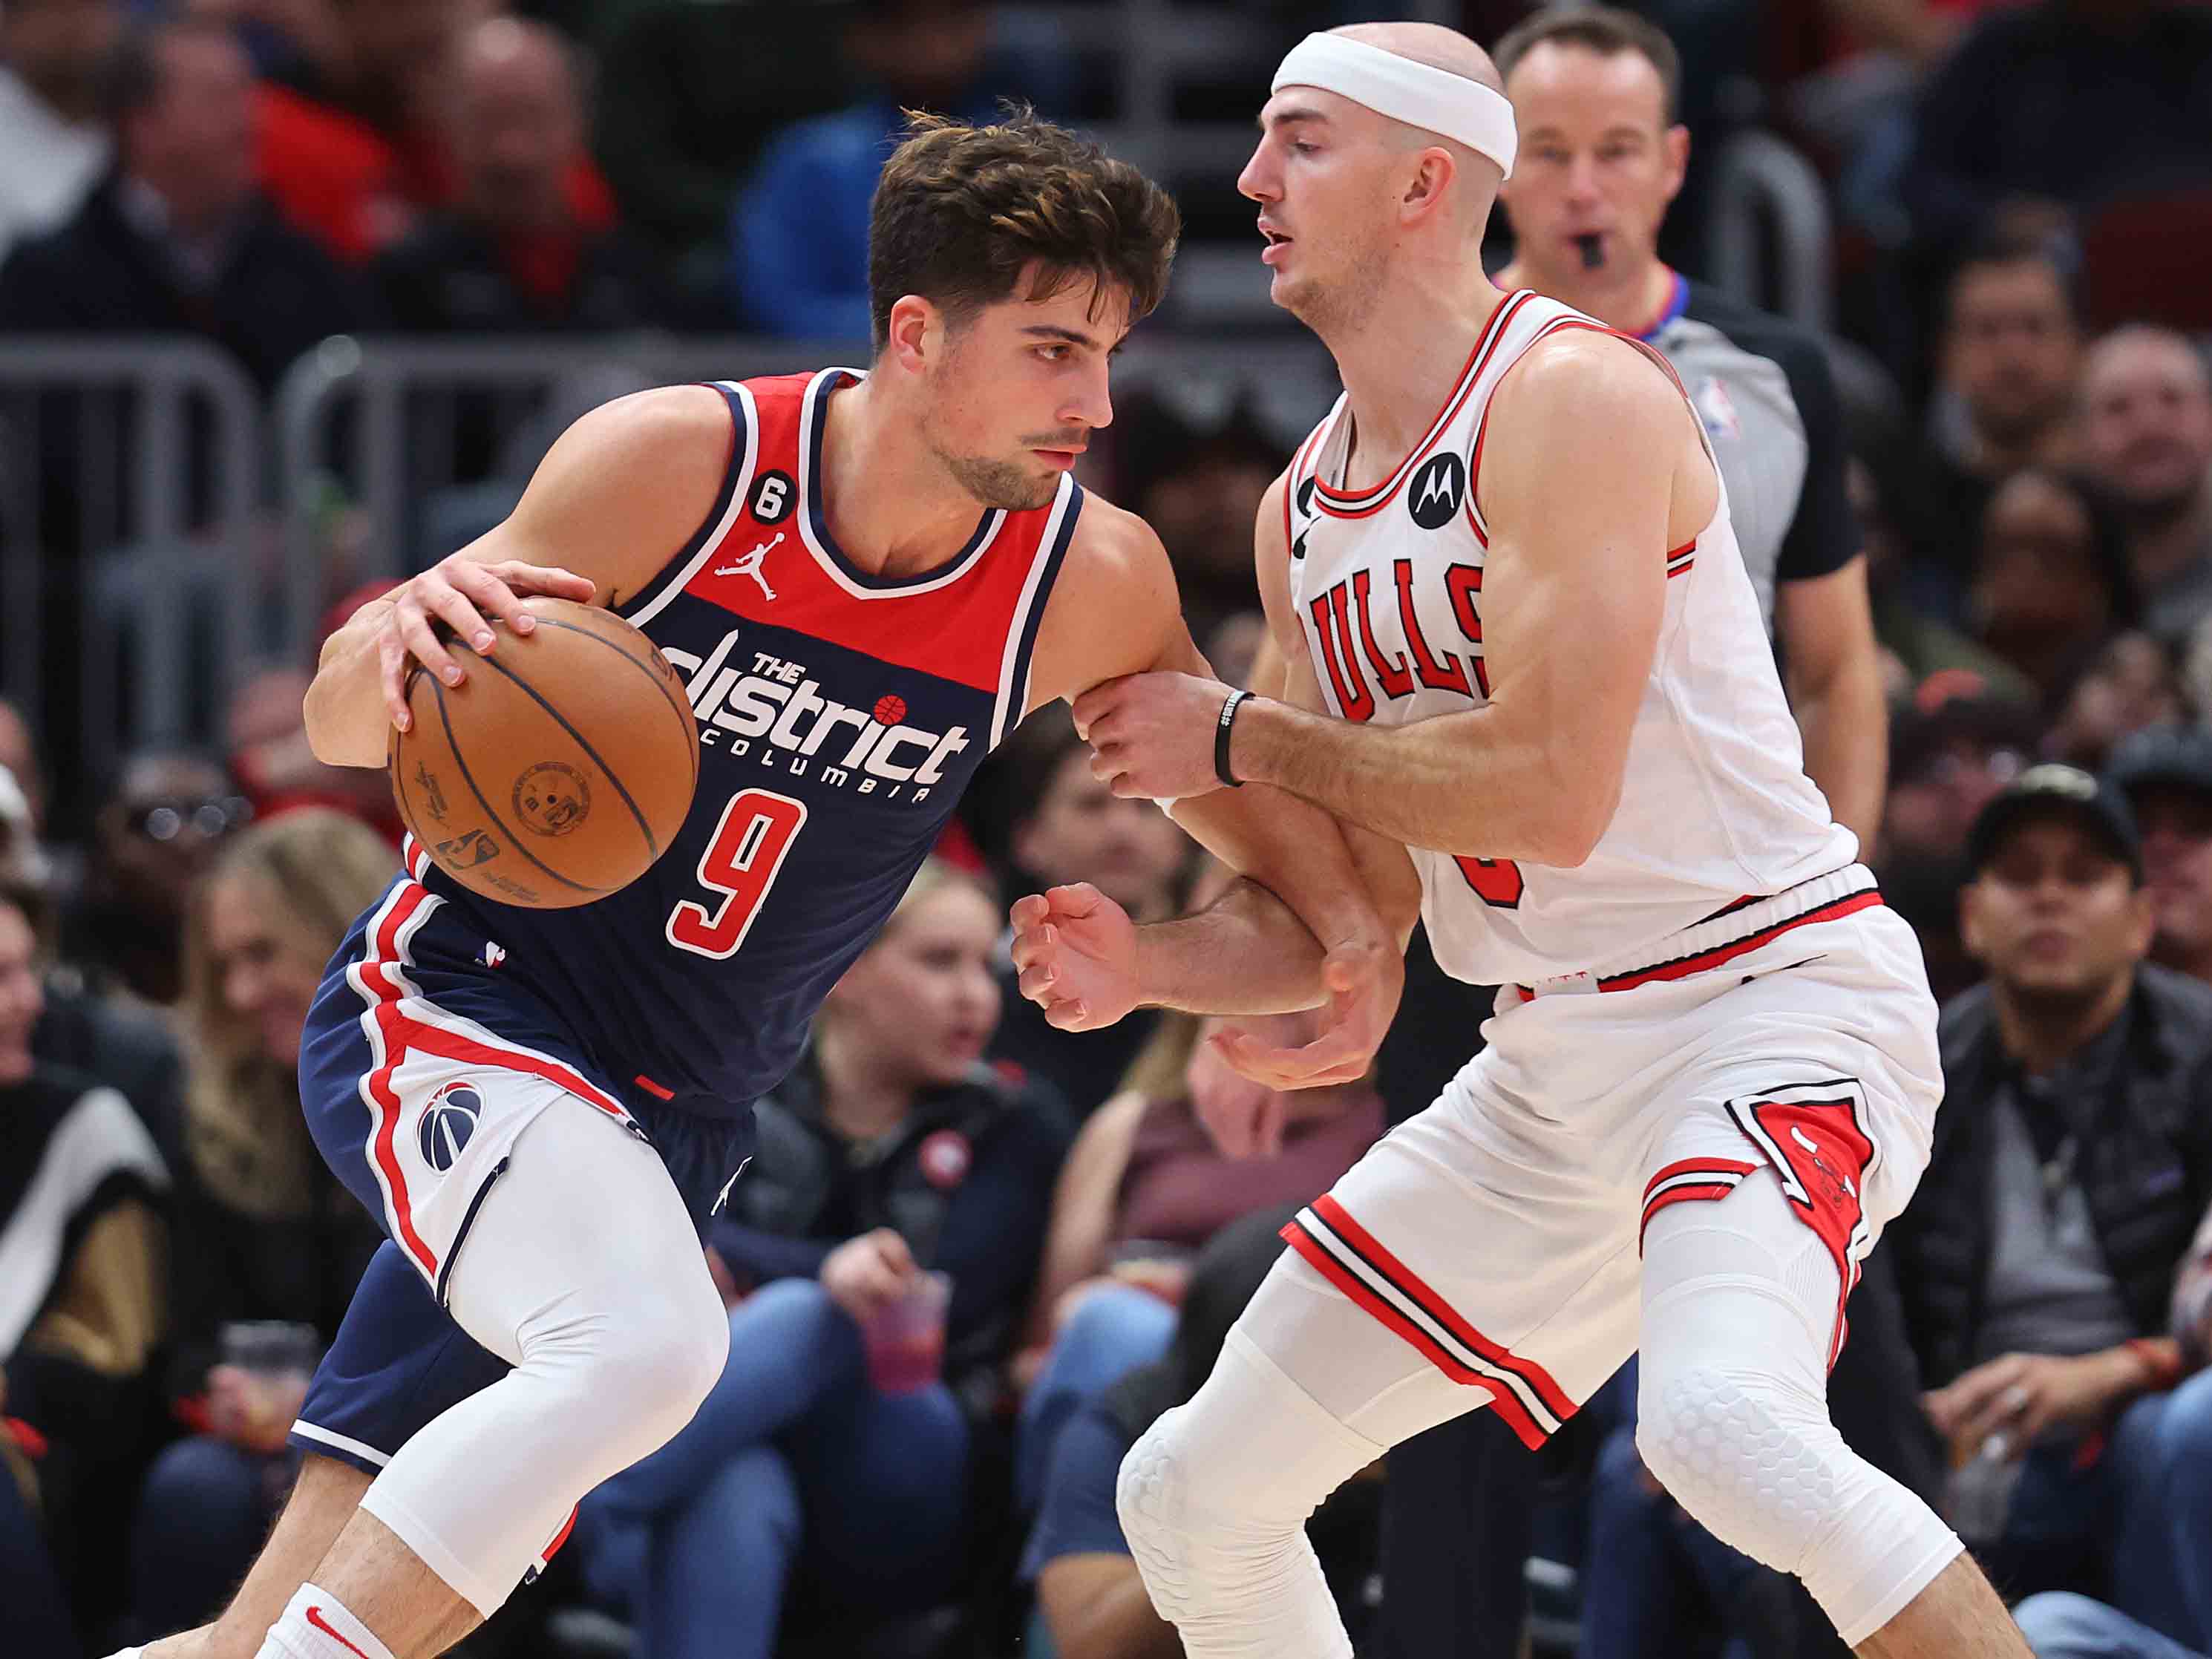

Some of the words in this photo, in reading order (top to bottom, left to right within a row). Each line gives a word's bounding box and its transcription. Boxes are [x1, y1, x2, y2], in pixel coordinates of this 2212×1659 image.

[755, 477, 788, 520] 6
[752, 652, 807, 684] THE
[1309, 557, 1491, 724] ULL
[699, 728, 931, 804] COLUMBIA
[666, 788, 808, 961] 9
